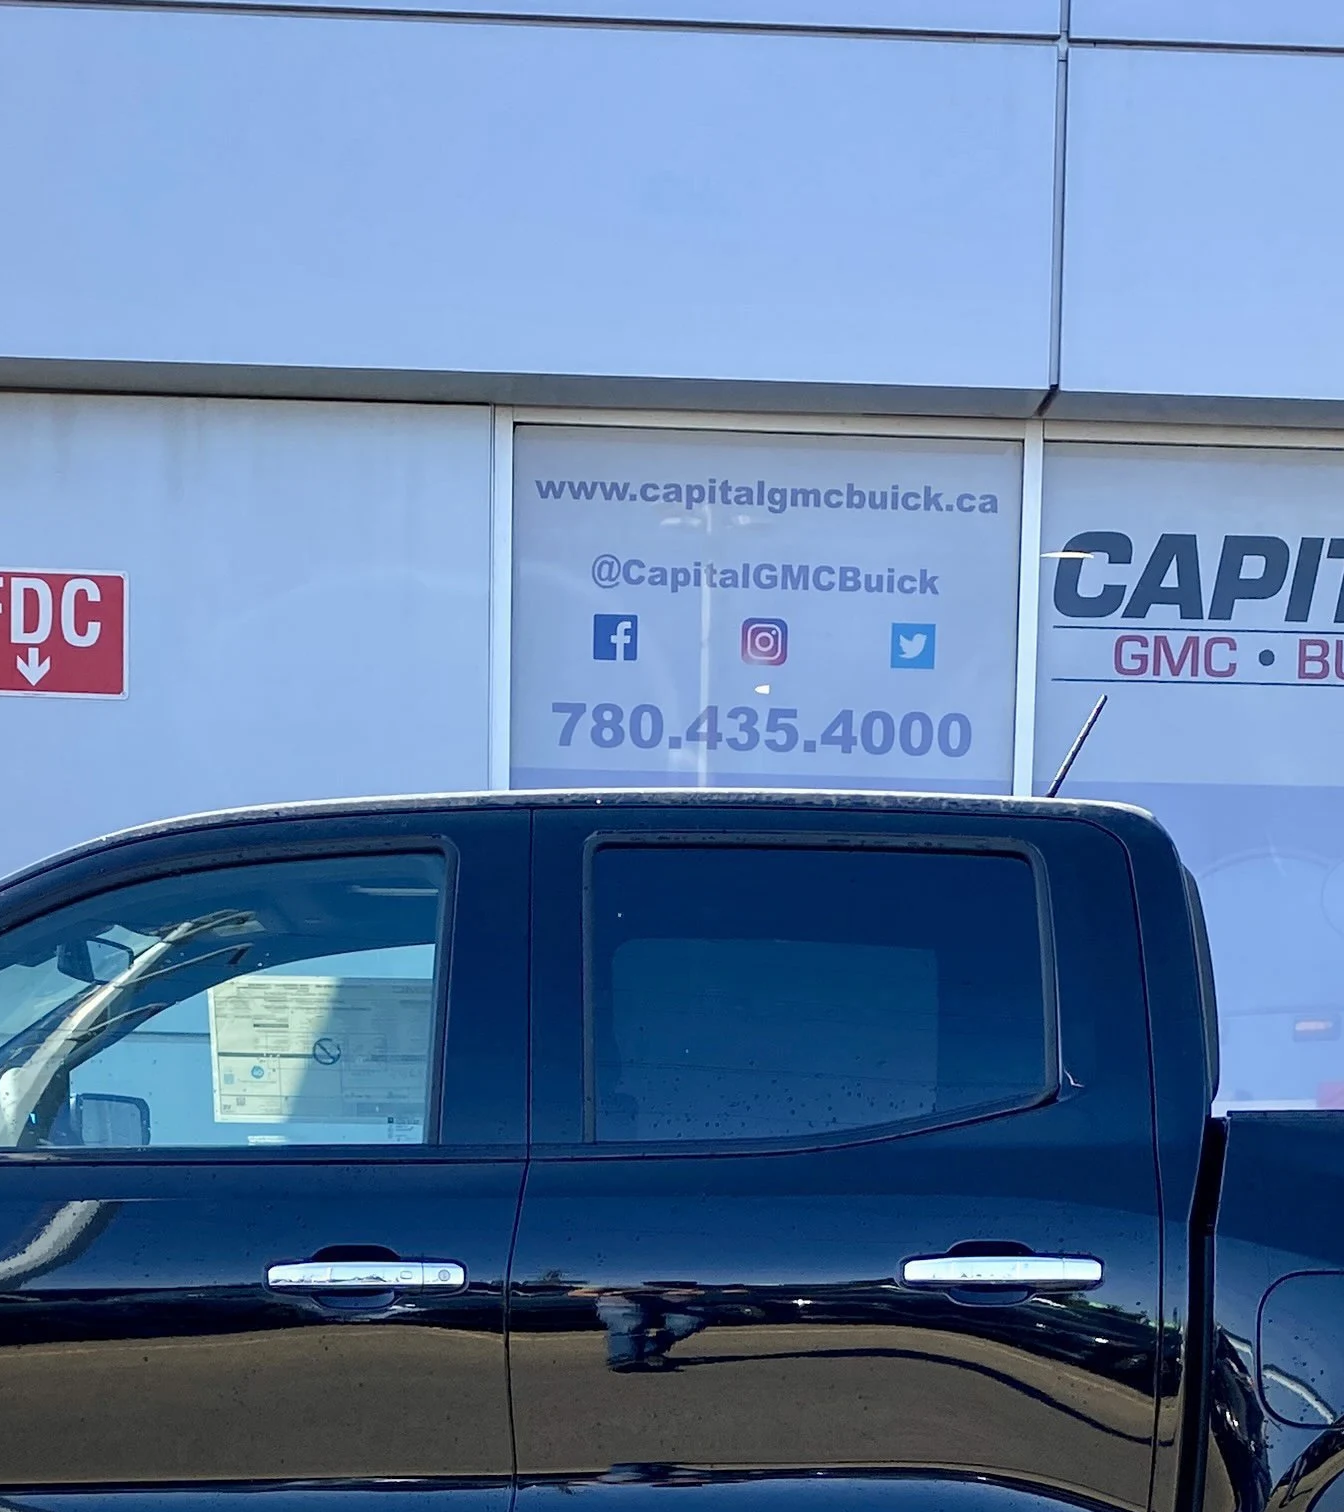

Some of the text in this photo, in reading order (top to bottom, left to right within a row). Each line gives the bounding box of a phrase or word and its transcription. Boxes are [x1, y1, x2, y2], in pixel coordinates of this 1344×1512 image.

[535, 478, 998, 514] www.capitalgmcbuick.ca
[592, 554, 939, 595] @CapitalGMCBuick
[1113, 635, 1237, 678] GMC
[551, 702, 972, 758] 780.435.4000
